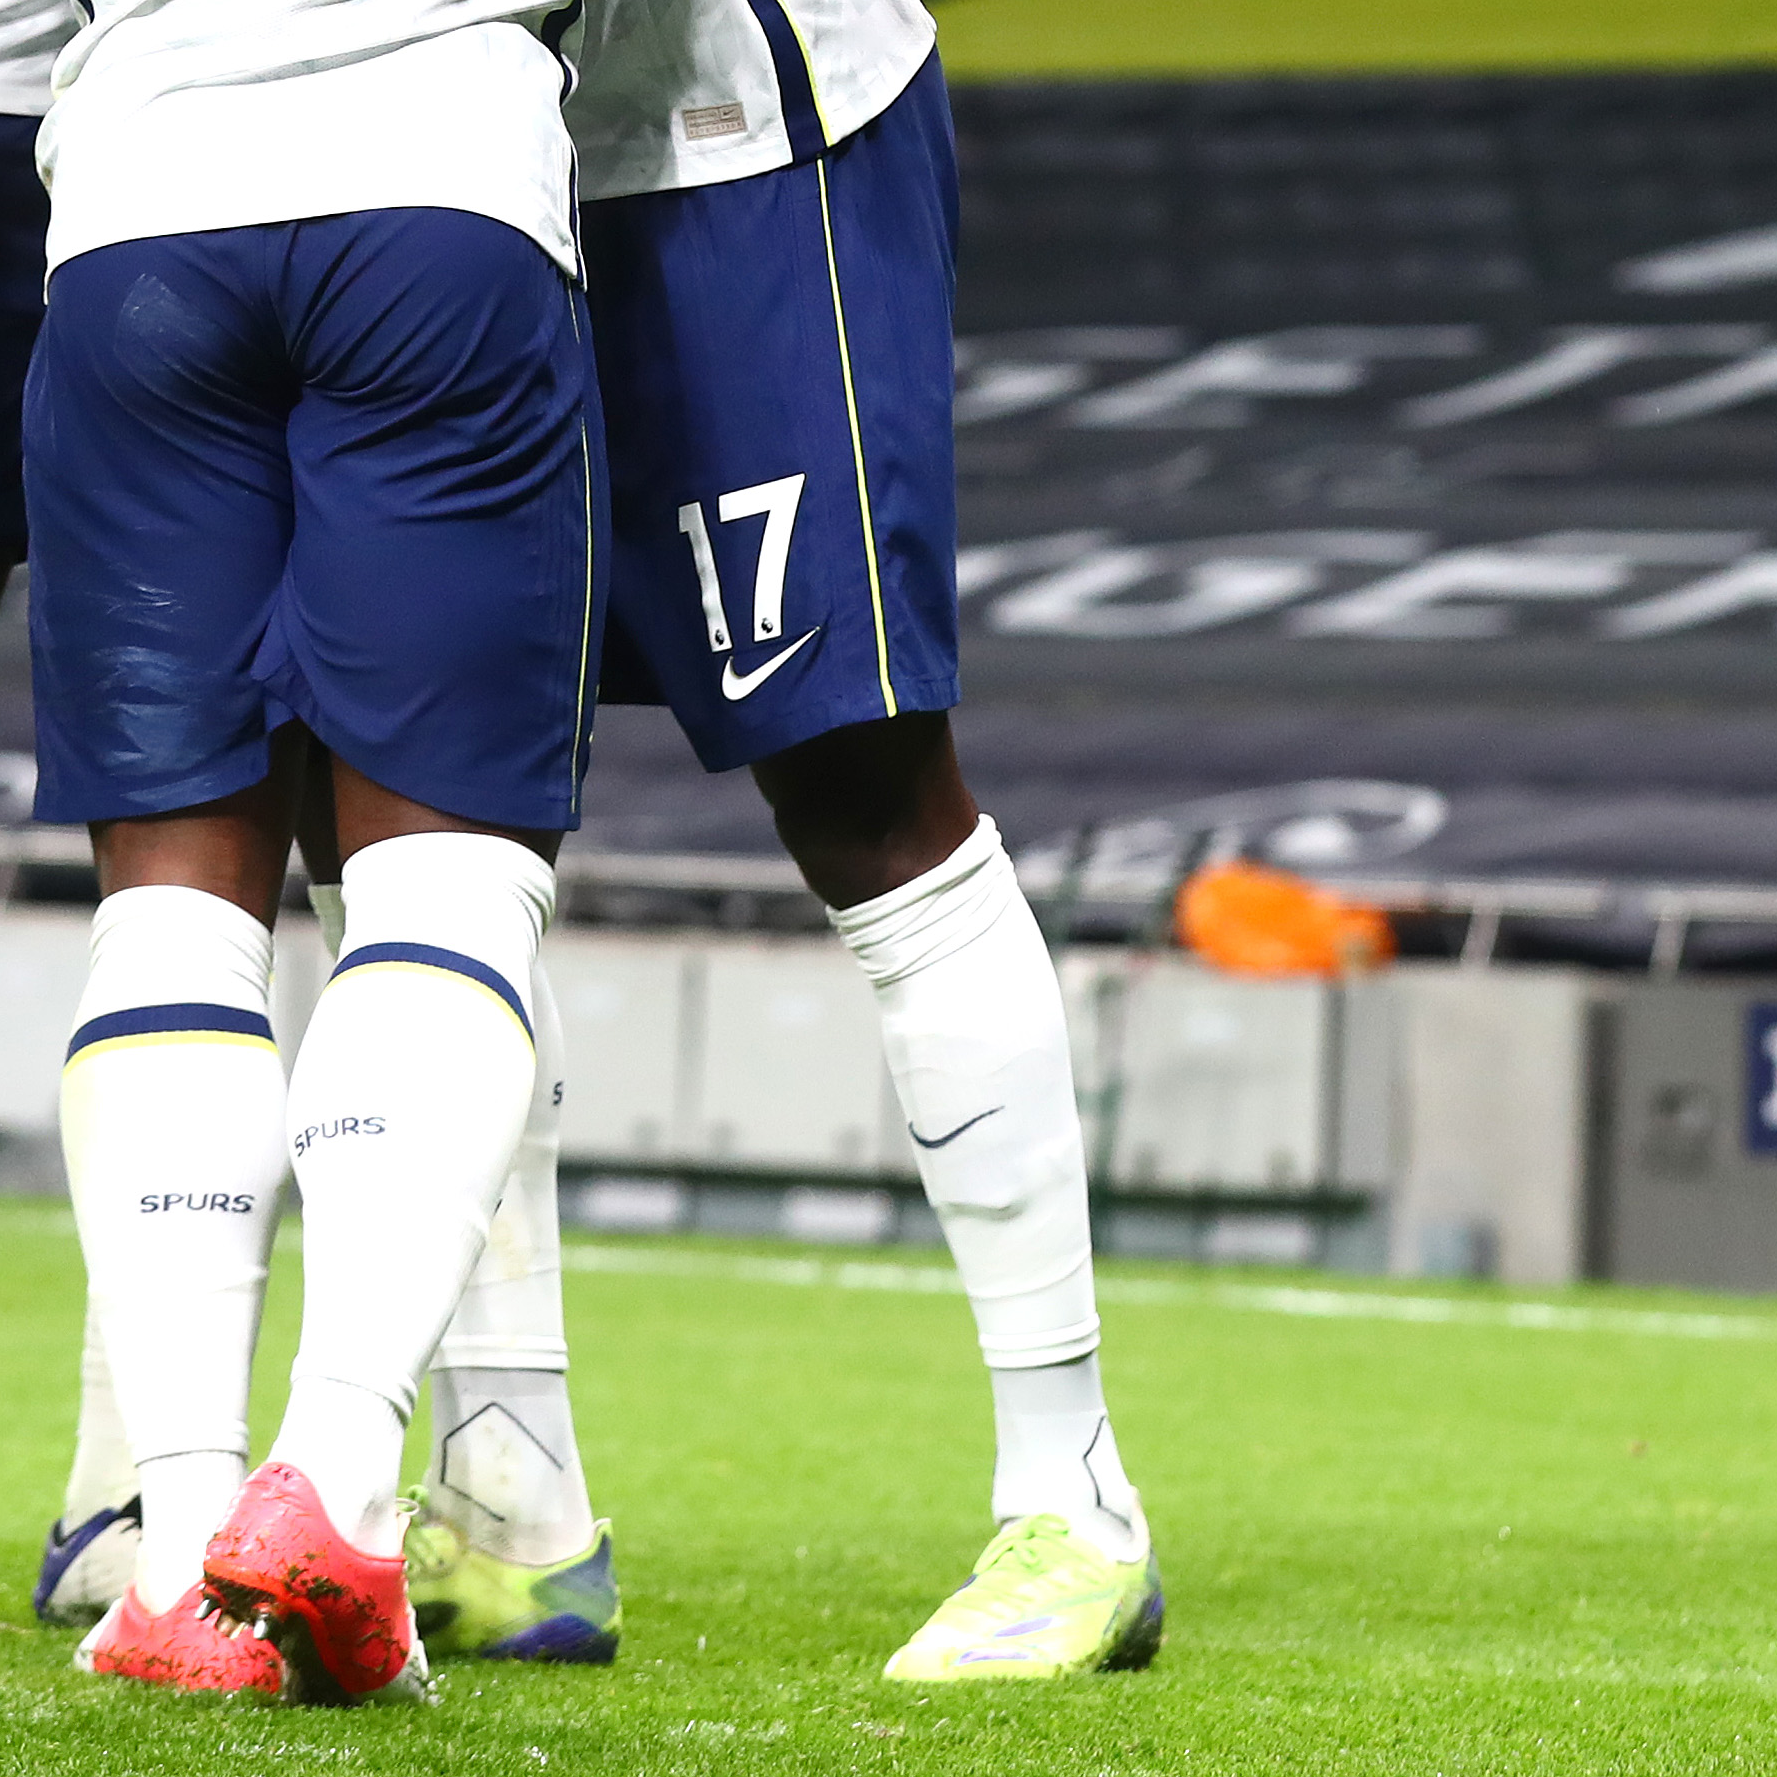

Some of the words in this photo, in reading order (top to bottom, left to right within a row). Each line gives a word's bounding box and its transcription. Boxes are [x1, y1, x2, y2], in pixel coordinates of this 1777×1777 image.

[677, 472, 807, 653] 17
[294, 1116, 386, 1157] SPURS
[139, 1192, 256, 1214] SPURS
